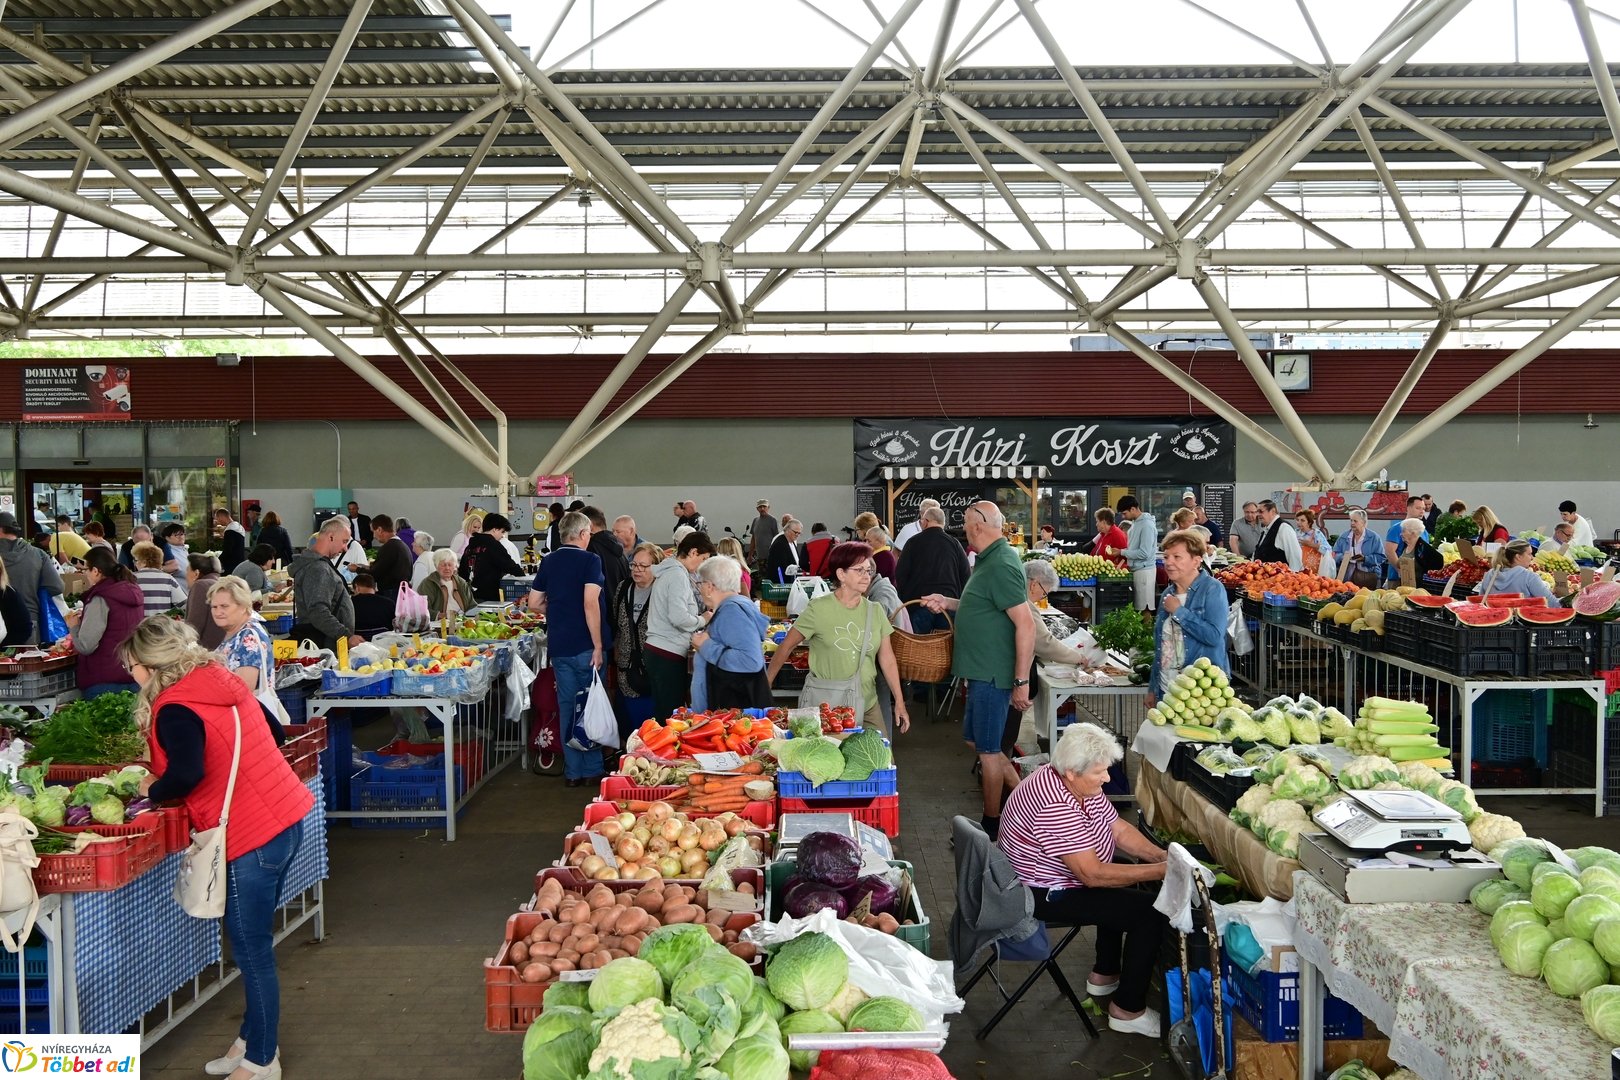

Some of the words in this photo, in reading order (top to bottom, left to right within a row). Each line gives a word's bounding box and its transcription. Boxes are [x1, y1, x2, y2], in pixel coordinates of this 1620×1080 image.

[25, 368, 78, 378] DOMINANT
[54, 377, 78, 385] BÁRÁNY
[930, 425, 1026, 468] Házi
[1050, 424, 1162, 467] Koszt
